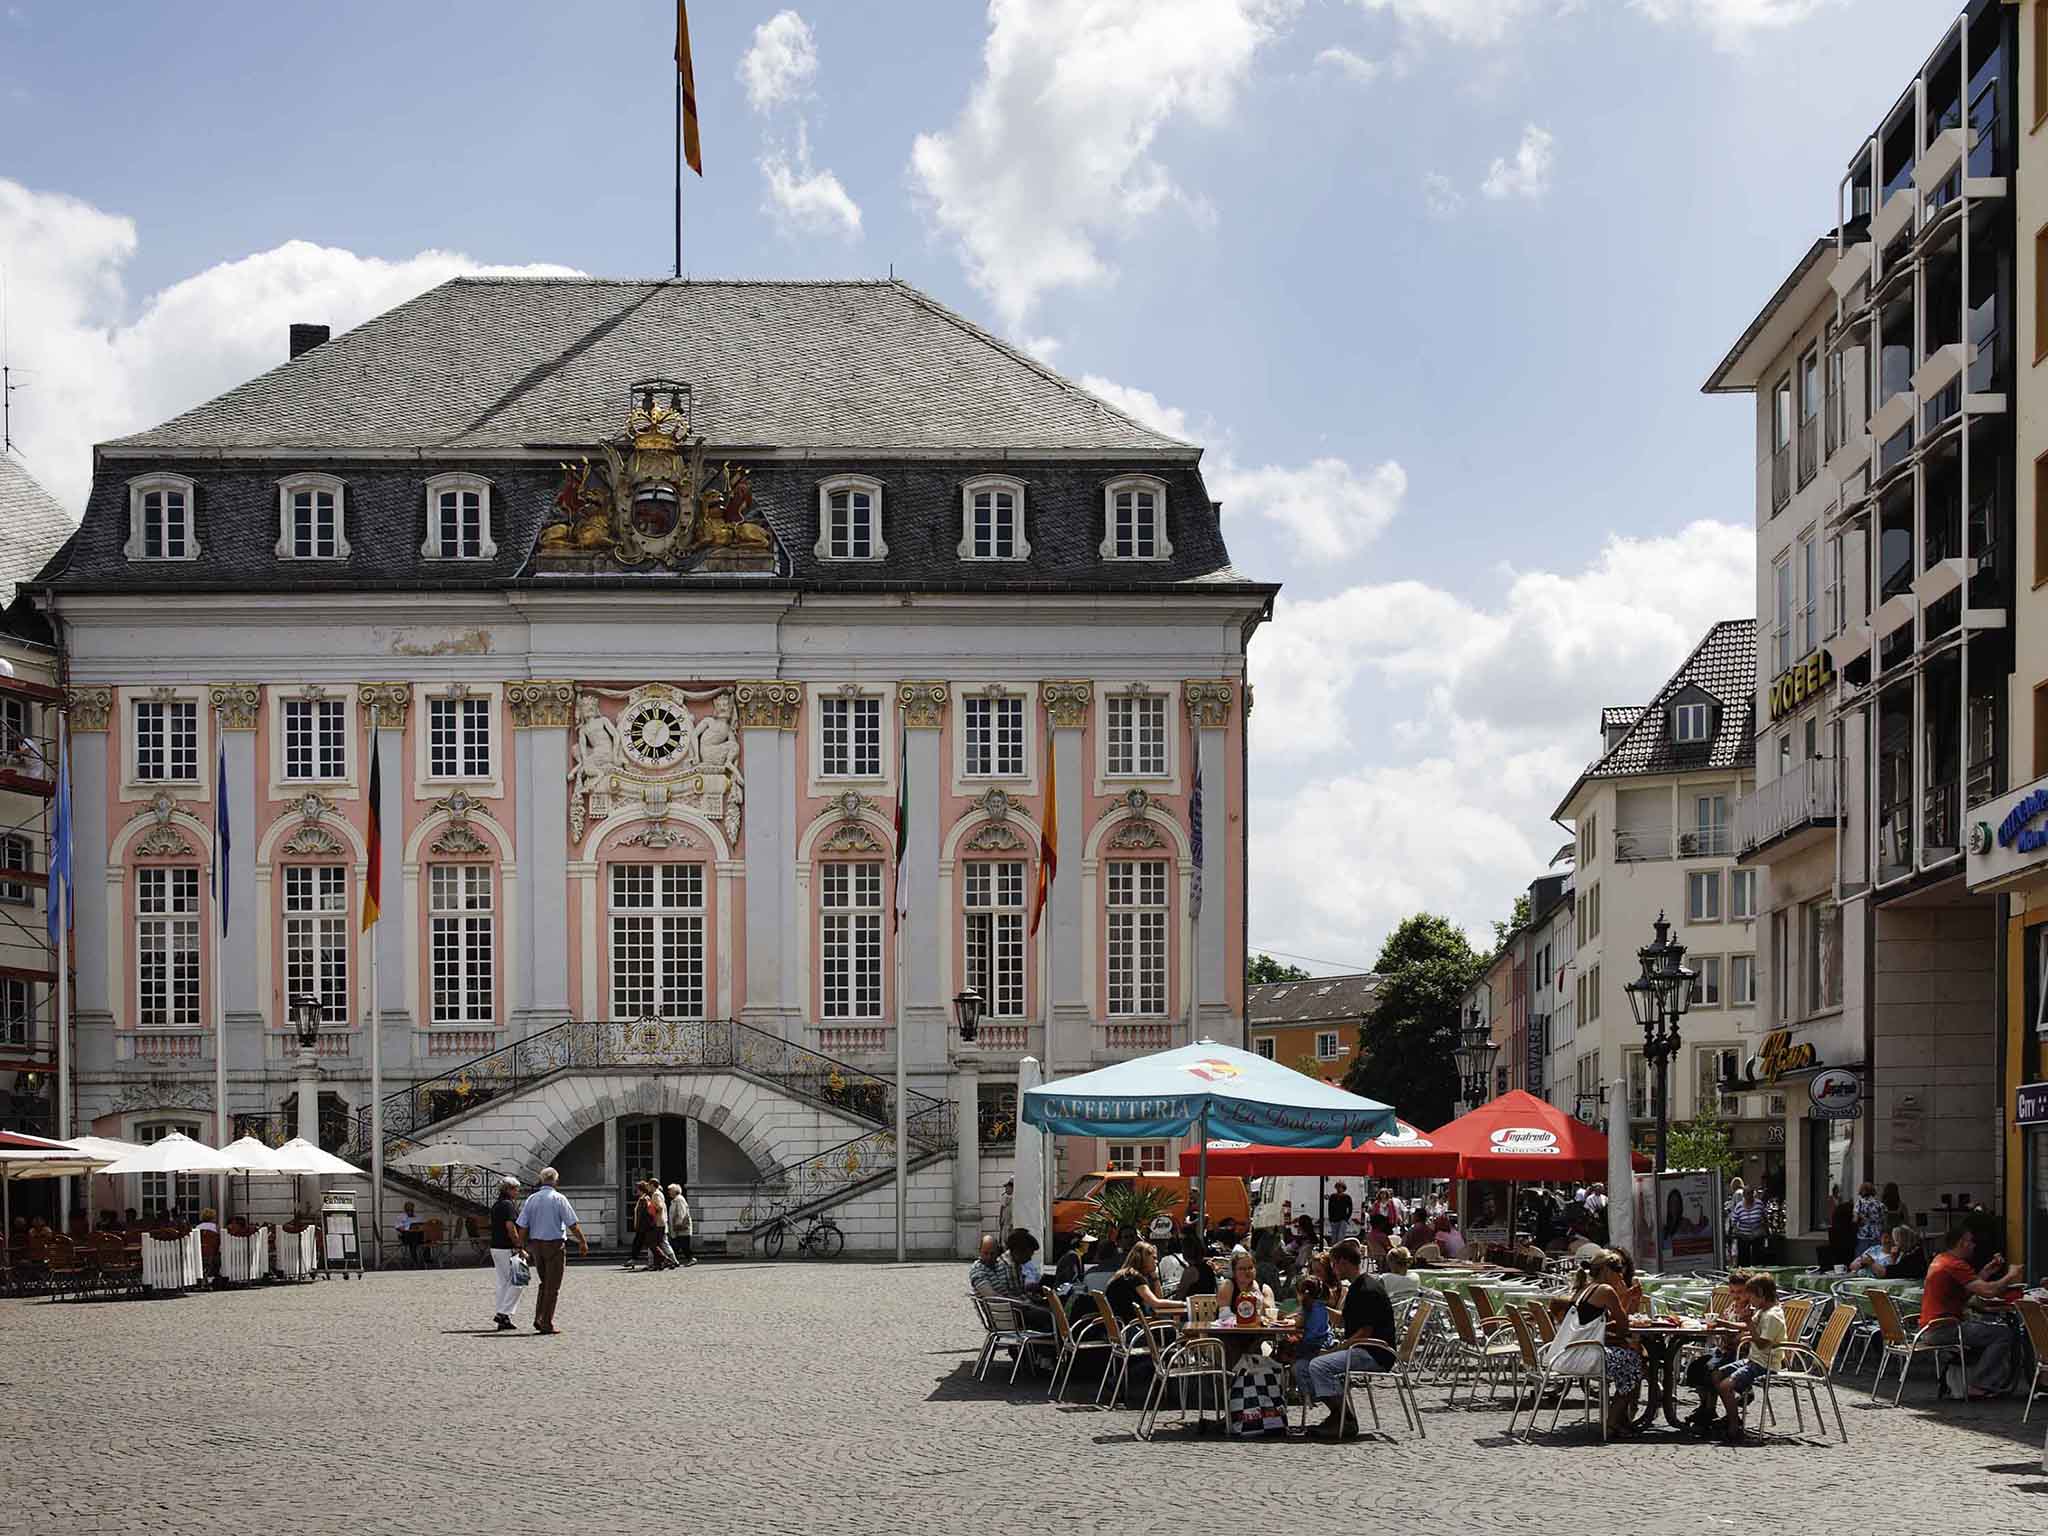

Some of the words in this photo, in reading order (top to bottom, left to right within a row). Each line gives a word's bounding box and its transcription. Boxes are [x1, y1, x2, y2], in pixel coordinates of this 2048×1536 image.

[1044, 1099, 1190, 1119] CAFFETTERIA
[1221, 1103, 1256, 1124] La
[1265, 1108, 1329, 1132] Dolce
[1497, 1130, 1551, 1143] Segafredo
